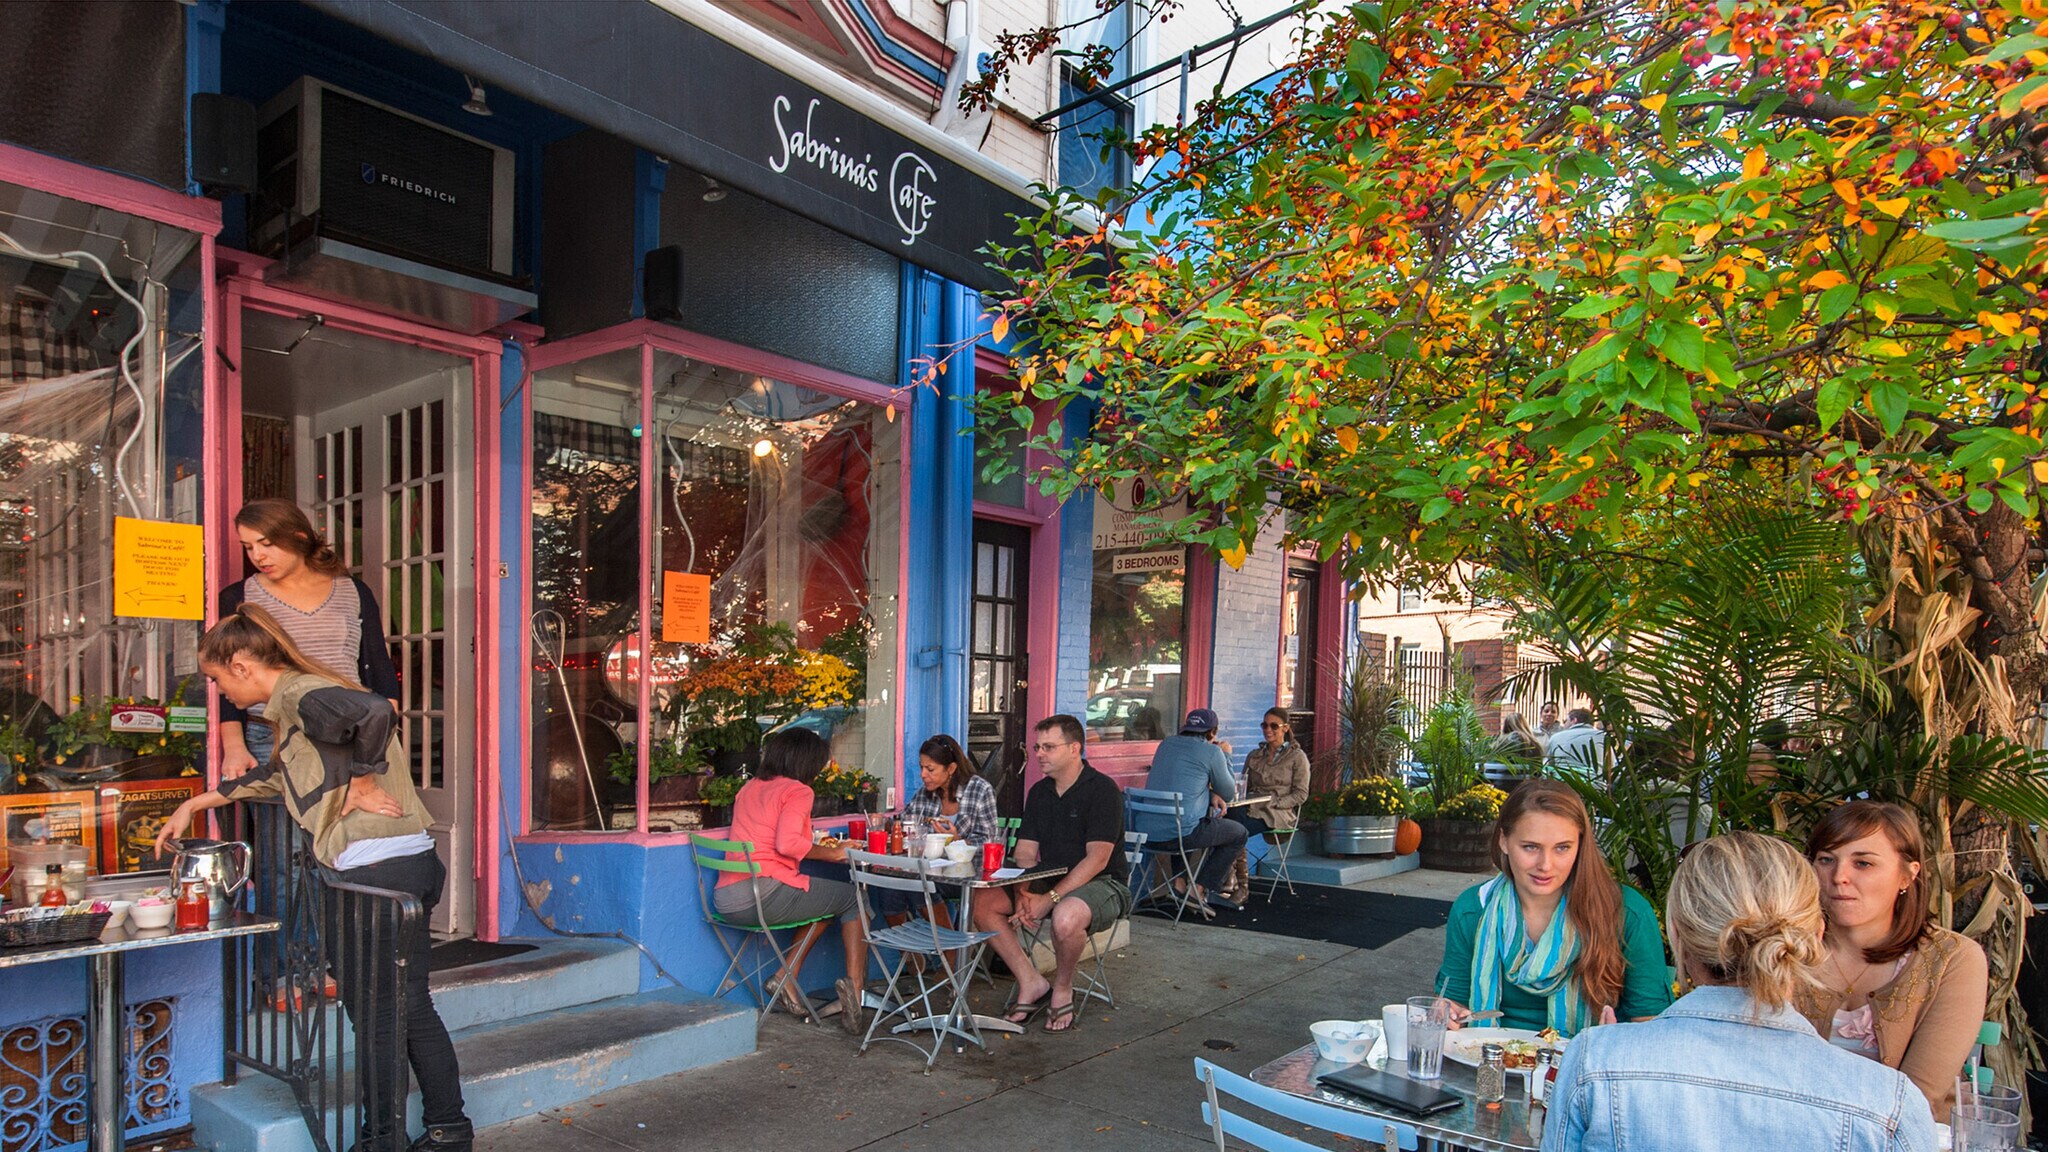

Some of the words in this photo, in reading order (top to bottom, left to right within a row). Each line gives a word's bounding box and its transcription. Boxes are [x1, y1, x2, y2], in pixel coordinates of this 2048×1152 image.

[769, 95, 878, 192] Sabrina's
[889, 151, 938, 246] Cafe
[381, 174, 456, 204] FRIEDRICH
[1116, 559, 1123, 570] 3
[1124, 555, 1179, 569] BEDROOMS
[999, 696, 1005, 710] 2
[49, 830, 80, 838] SURVEY
